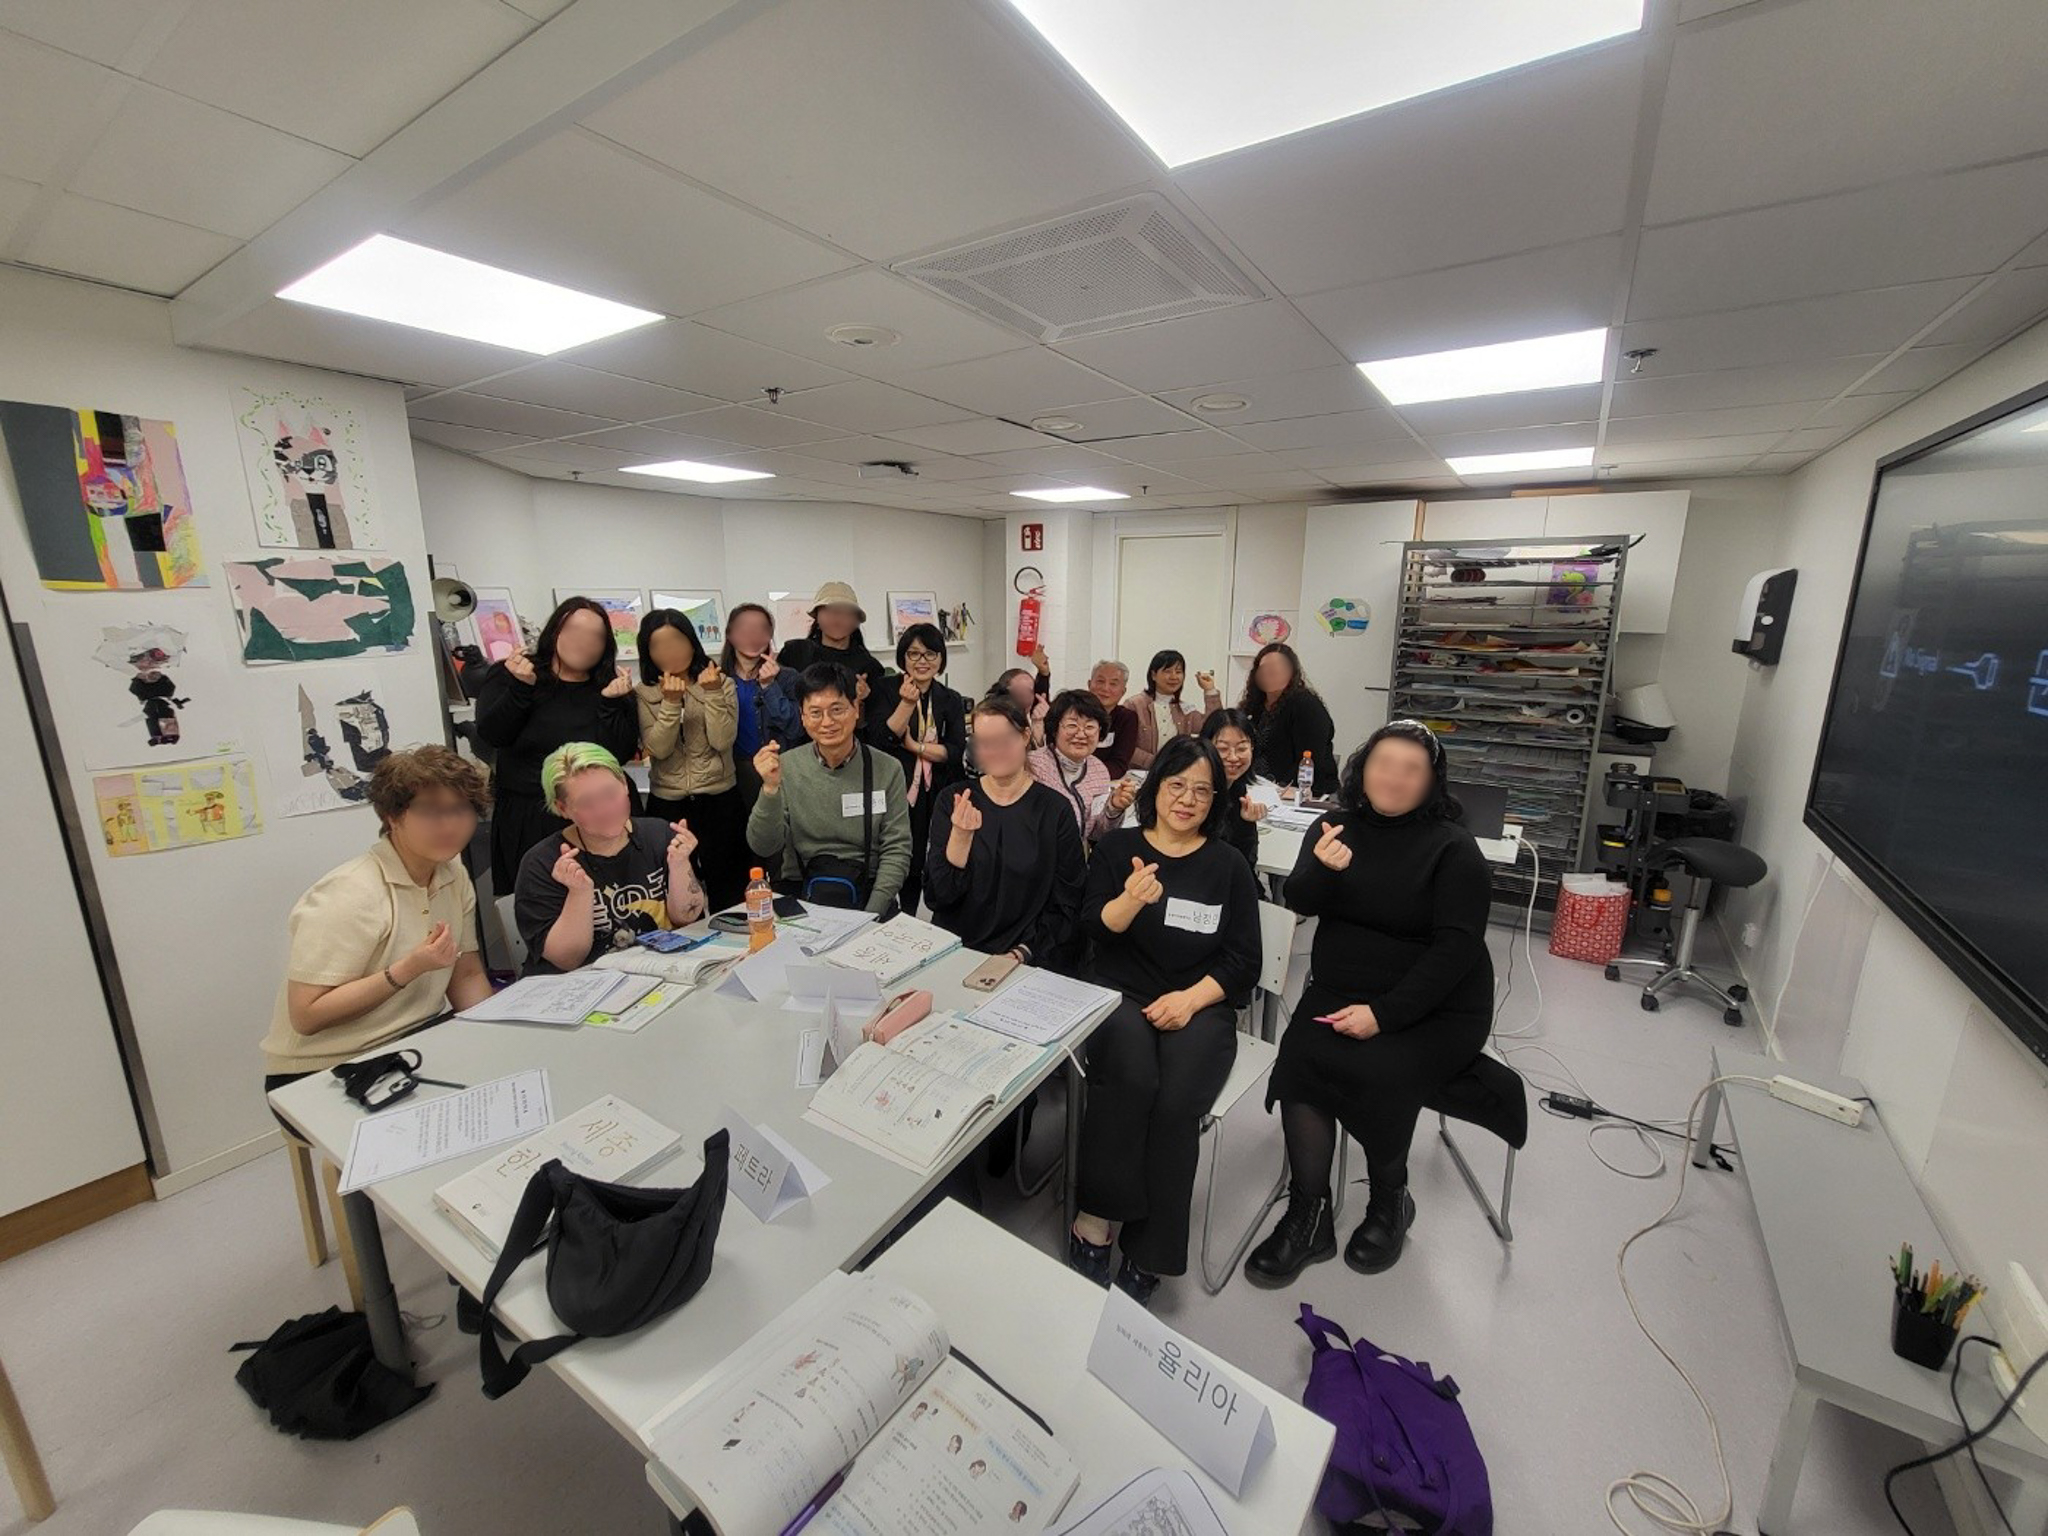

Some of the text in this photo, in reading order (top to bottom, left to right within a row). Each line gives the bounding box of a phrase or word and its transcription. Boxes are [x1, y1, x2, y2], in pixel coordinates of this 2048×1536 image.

[579, 1119, 639, 1158] 세종
[496, 1148, 542, 1180] 한
[733, 1143, 774, 1195] 페트라
[1158, 1340, 1238, 1426] 율리아
